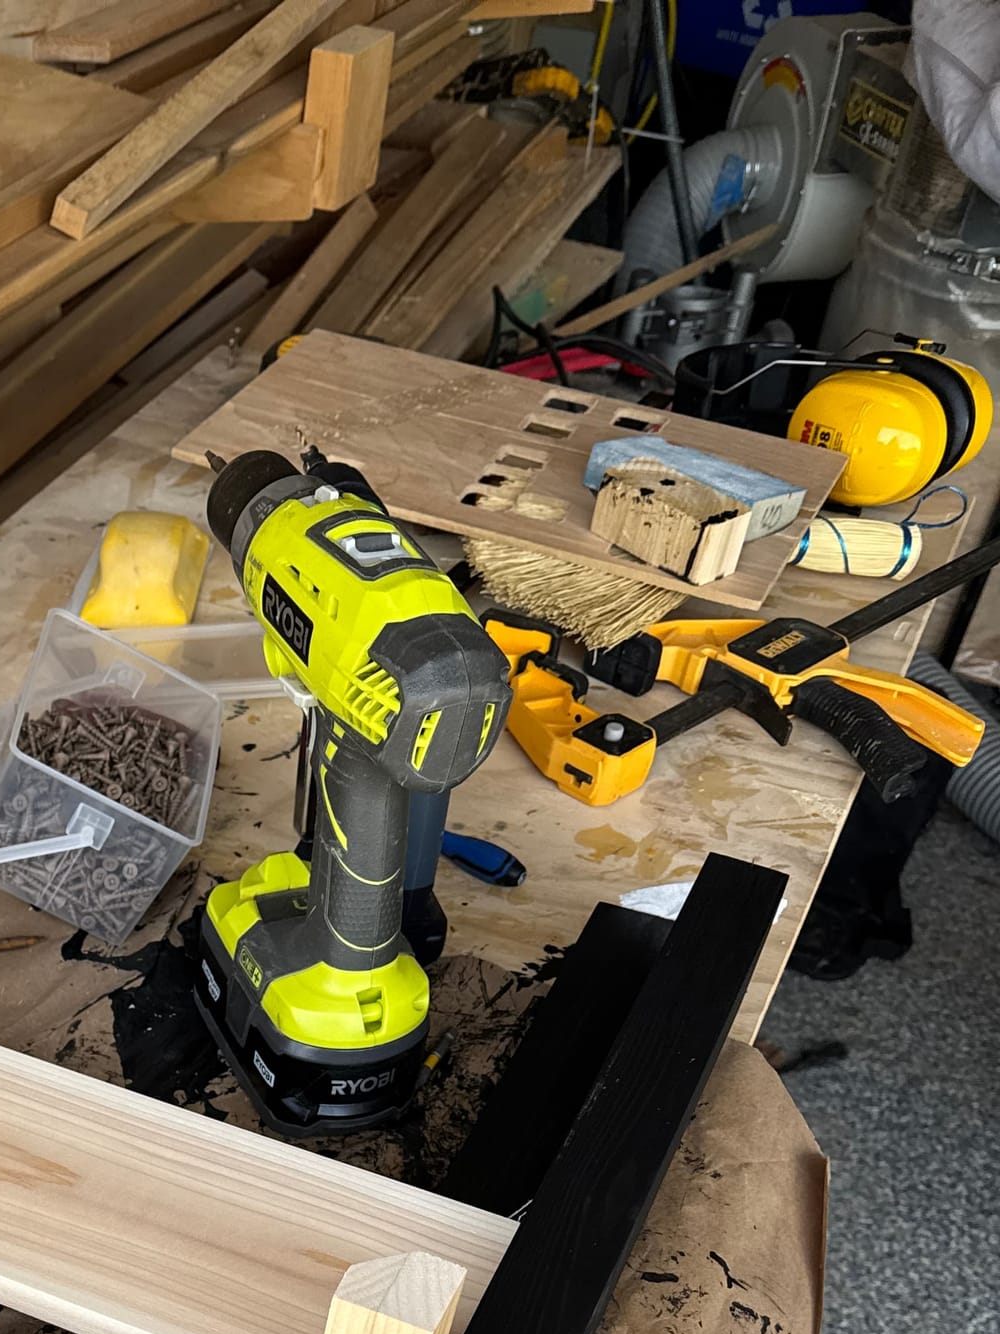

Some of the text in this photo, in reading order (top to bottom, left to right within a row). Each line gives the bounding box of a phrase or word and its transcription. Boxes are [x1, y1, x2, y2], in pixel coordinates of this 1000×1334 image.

[265, 583, 310, 656] RYOBI
[254, 1053, 274, 1086] RYOBI
[331, 1068, 395, 1096] RYOBI
